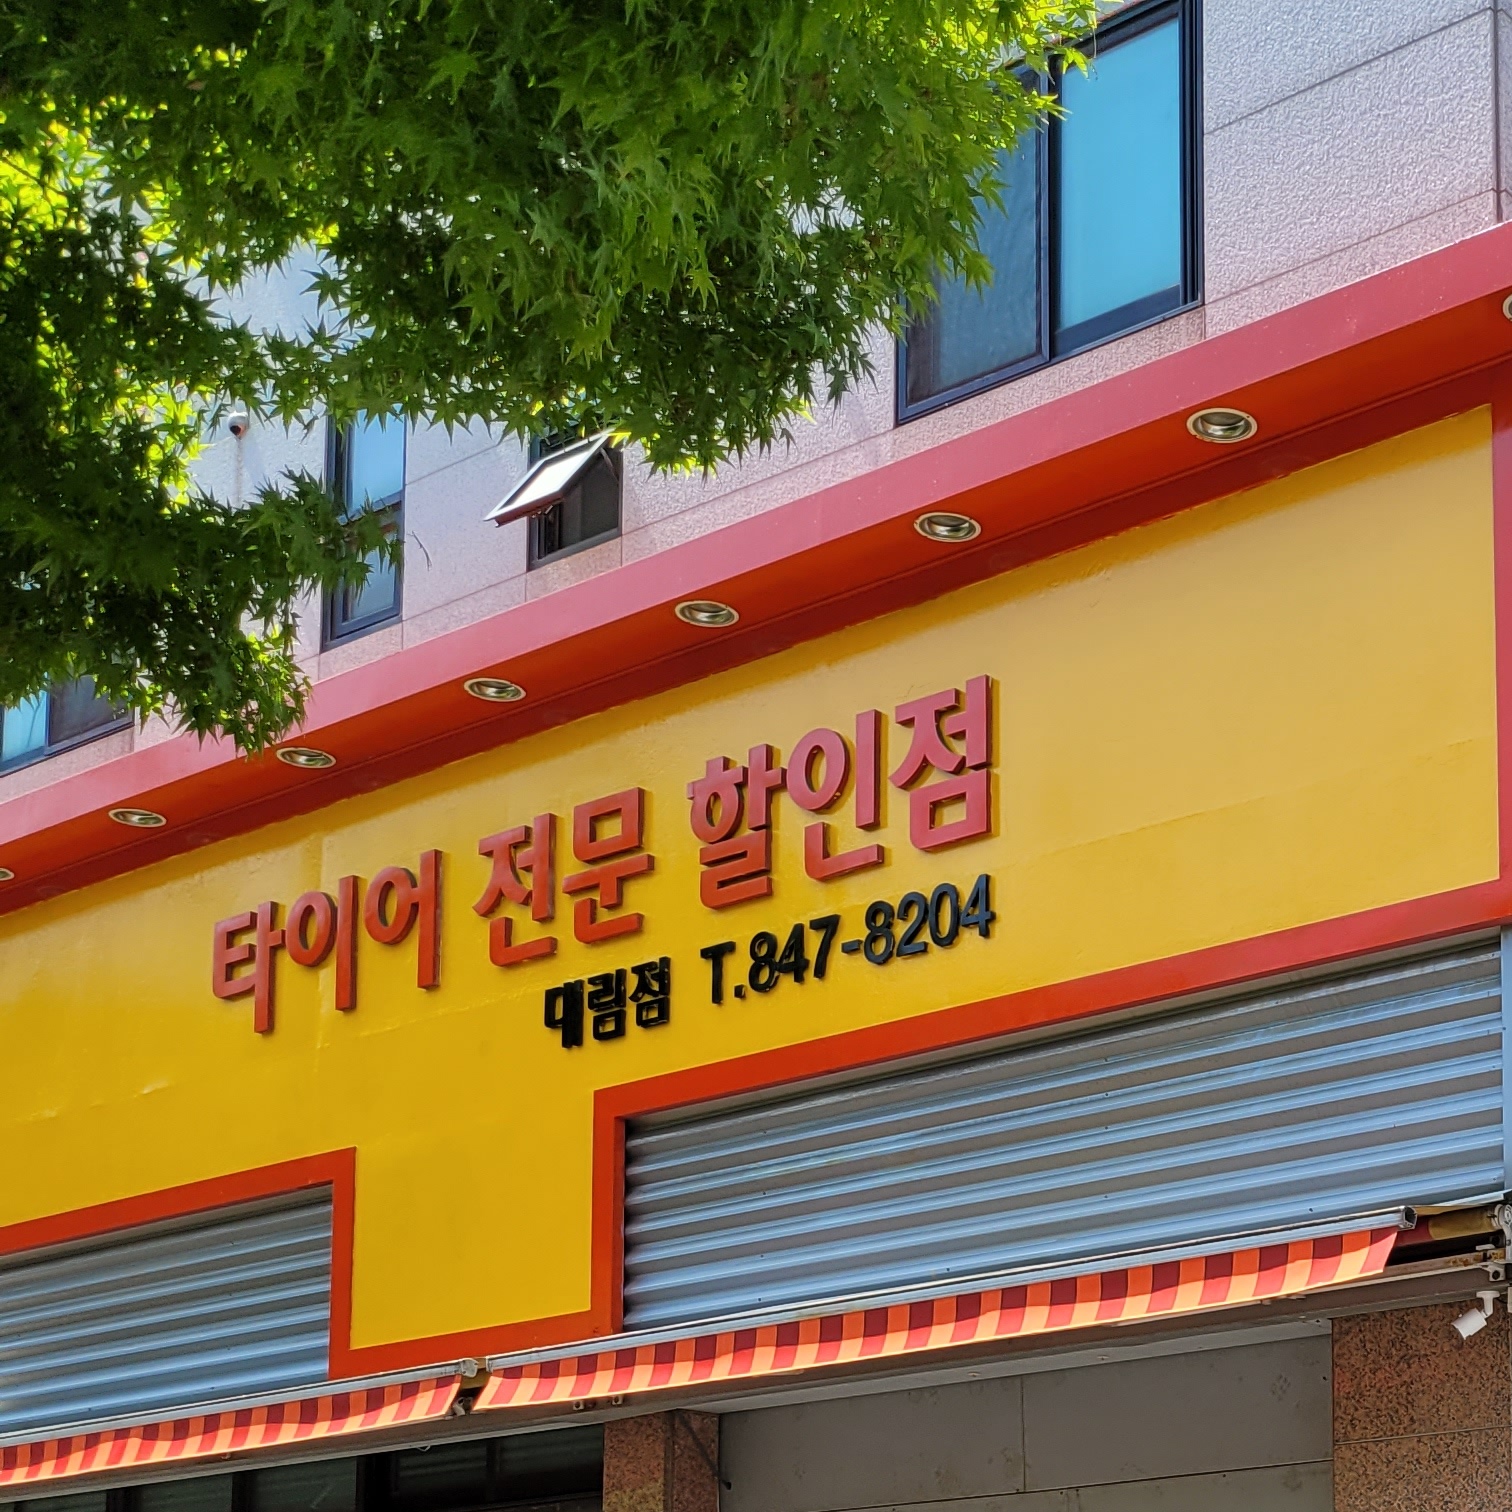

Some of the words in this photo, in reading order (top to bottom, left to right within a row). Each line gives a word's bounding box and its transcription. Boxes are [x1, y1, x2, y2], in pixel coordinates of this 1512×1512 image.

[212, 848, 443, 1034] 타이어
[473, 786, 655, 968] 전문
[688, 674, 998, 911] 할인점
[543, 955, 672, 1049] 대림점
